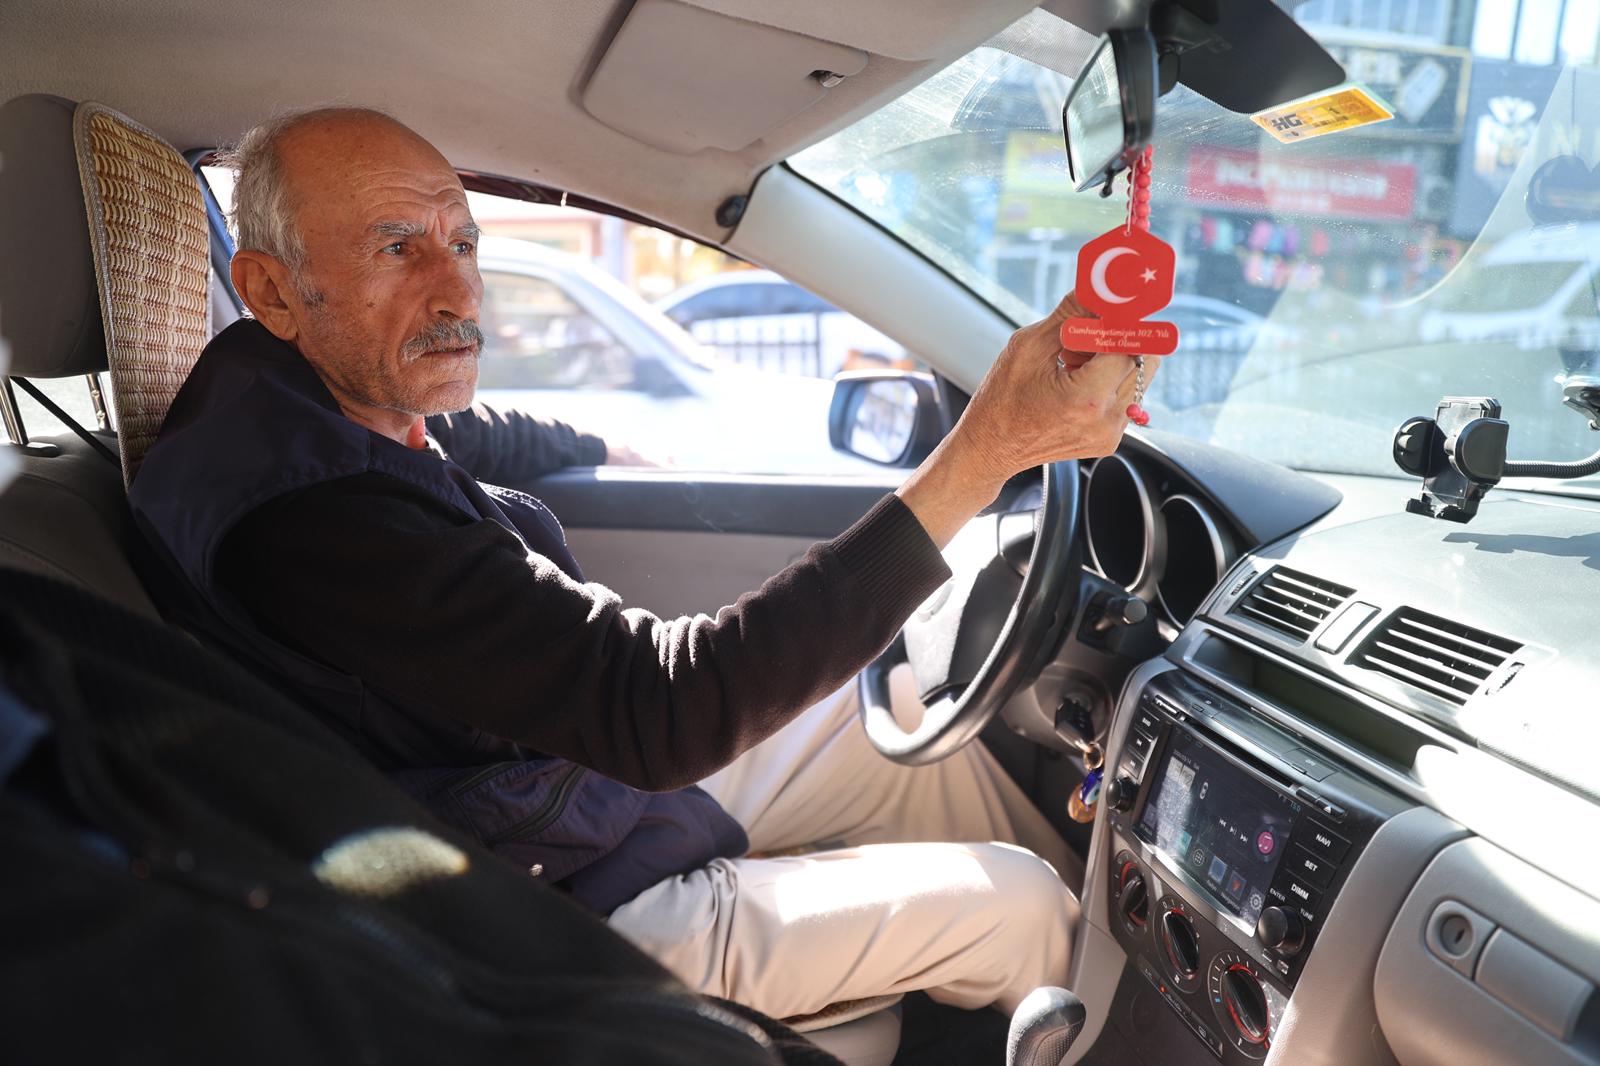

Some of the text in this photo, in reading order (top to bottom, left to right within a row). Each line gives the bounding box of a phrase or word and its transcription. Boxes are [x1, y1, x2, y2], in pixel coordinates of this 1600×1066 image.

[1094, 338, 1141, 348] Kutlu Olsun
[1315, 833, 1332, 848] NAVI
[1304, 860, 1318, 872] SET
[1269, 888, 1286, 902] ENTER
[1291, 883, 1310, 900] DIMM
[1300, 908, 1315, 922] TUNE
